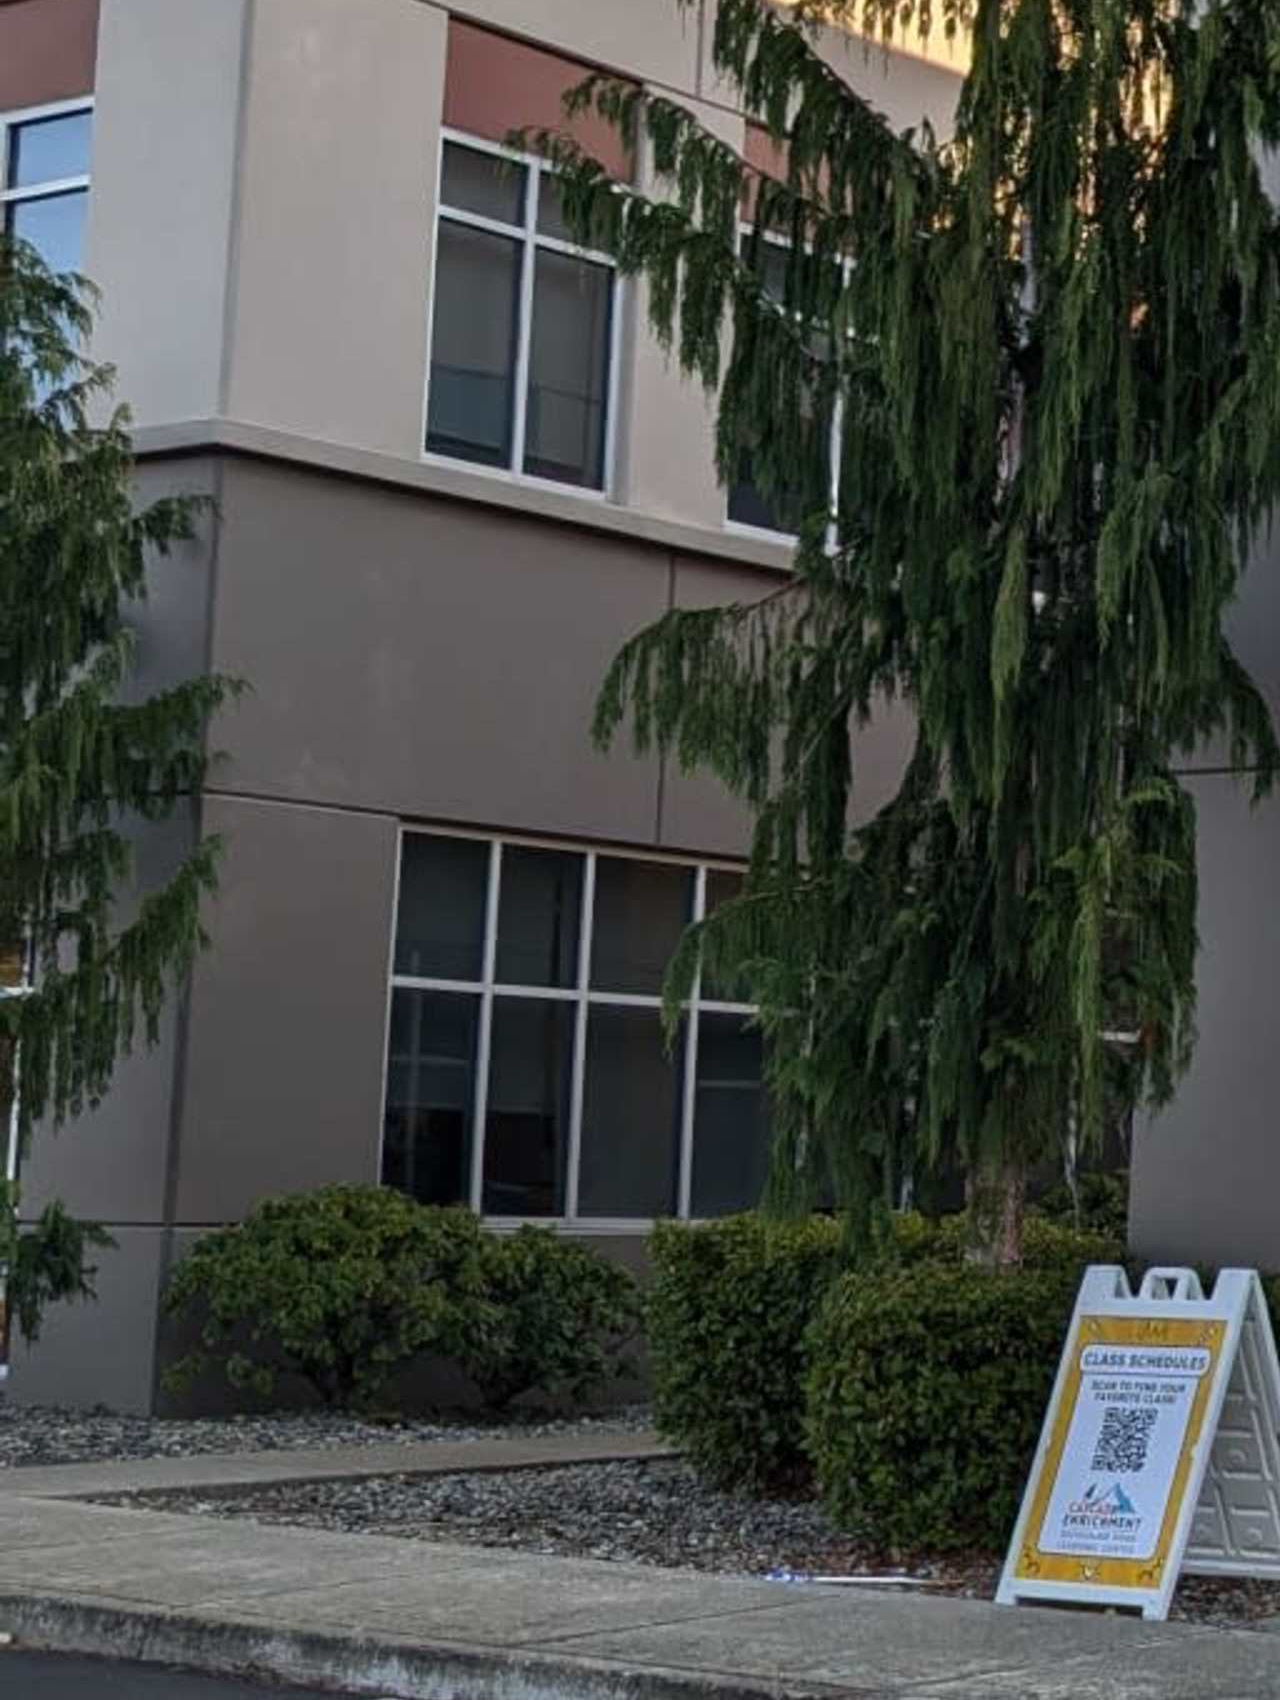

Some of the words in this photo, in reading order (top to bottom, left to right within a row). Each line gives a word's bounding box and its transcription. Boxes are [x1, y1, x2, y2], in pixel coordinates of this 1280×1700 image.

[1084, 1353, 1126, 1367] CLASS
[1129, 1354, 1208, 1371] SCHEDULES
[1061, 1513, 1142, 1531] ENRICHMENT
